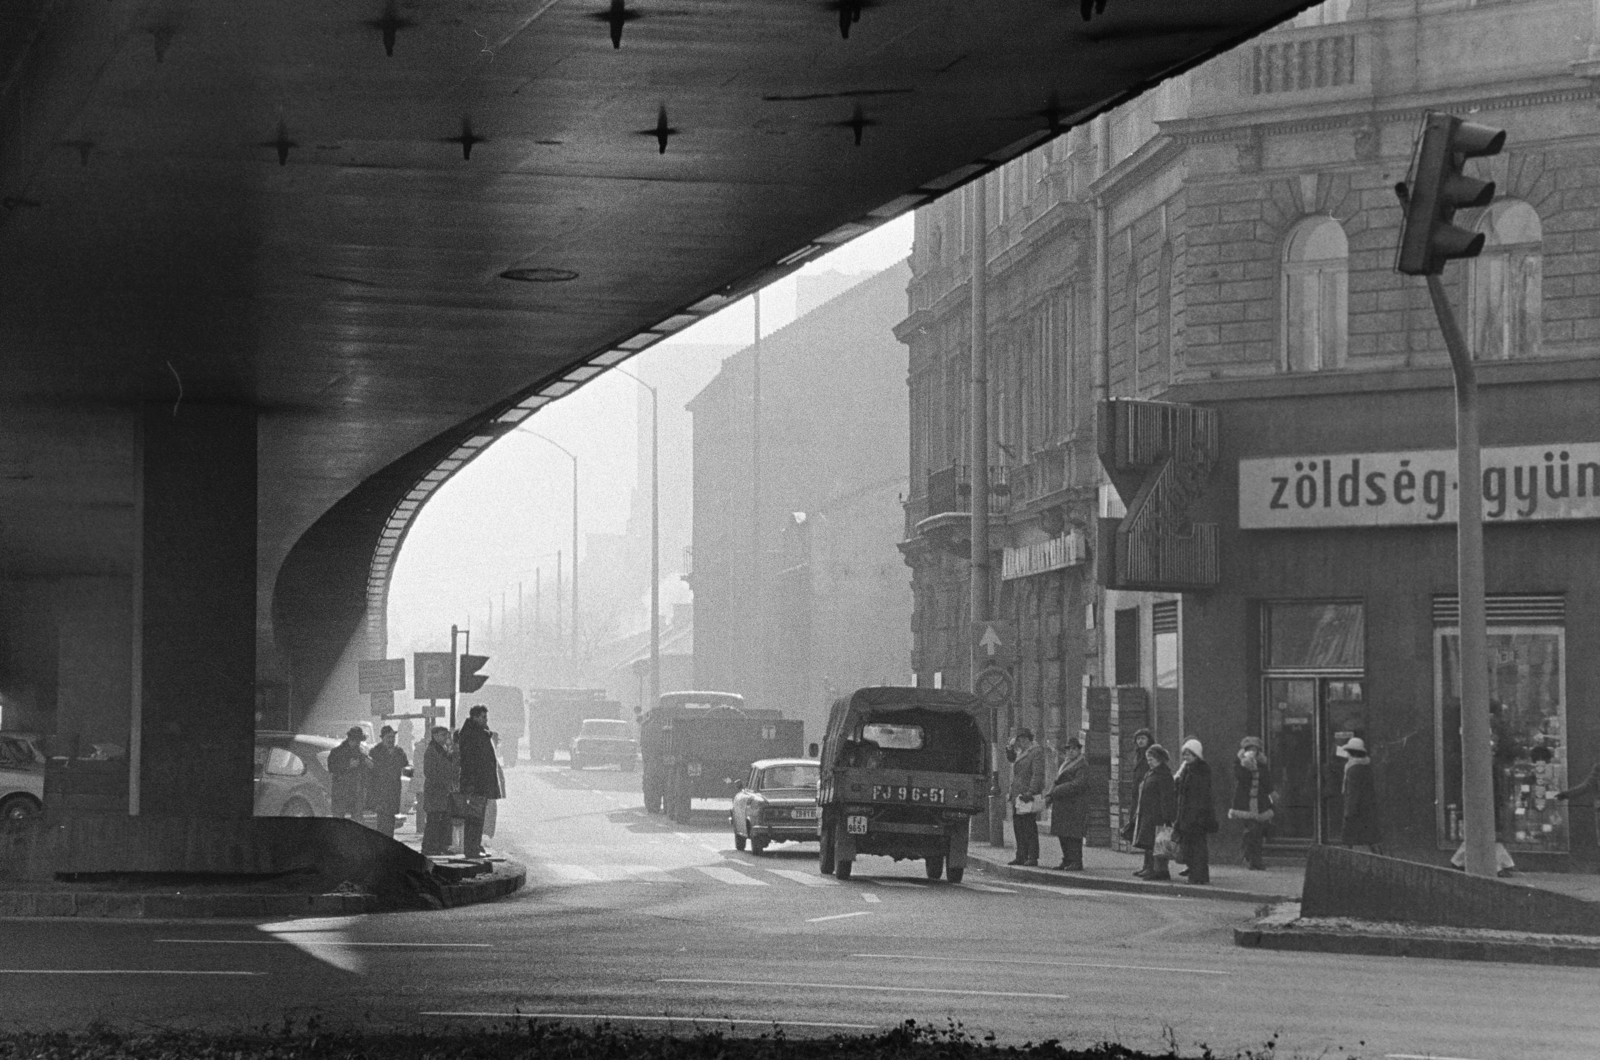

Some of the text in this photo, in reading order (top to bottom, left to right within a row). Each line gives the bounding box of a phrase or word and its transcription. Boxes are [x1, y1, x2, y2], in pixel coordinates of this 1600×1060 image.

[873, 785, 891, 800] FJ
[853, 815, 863, 824] FJ
[848, 825, 865, 834] 9651
